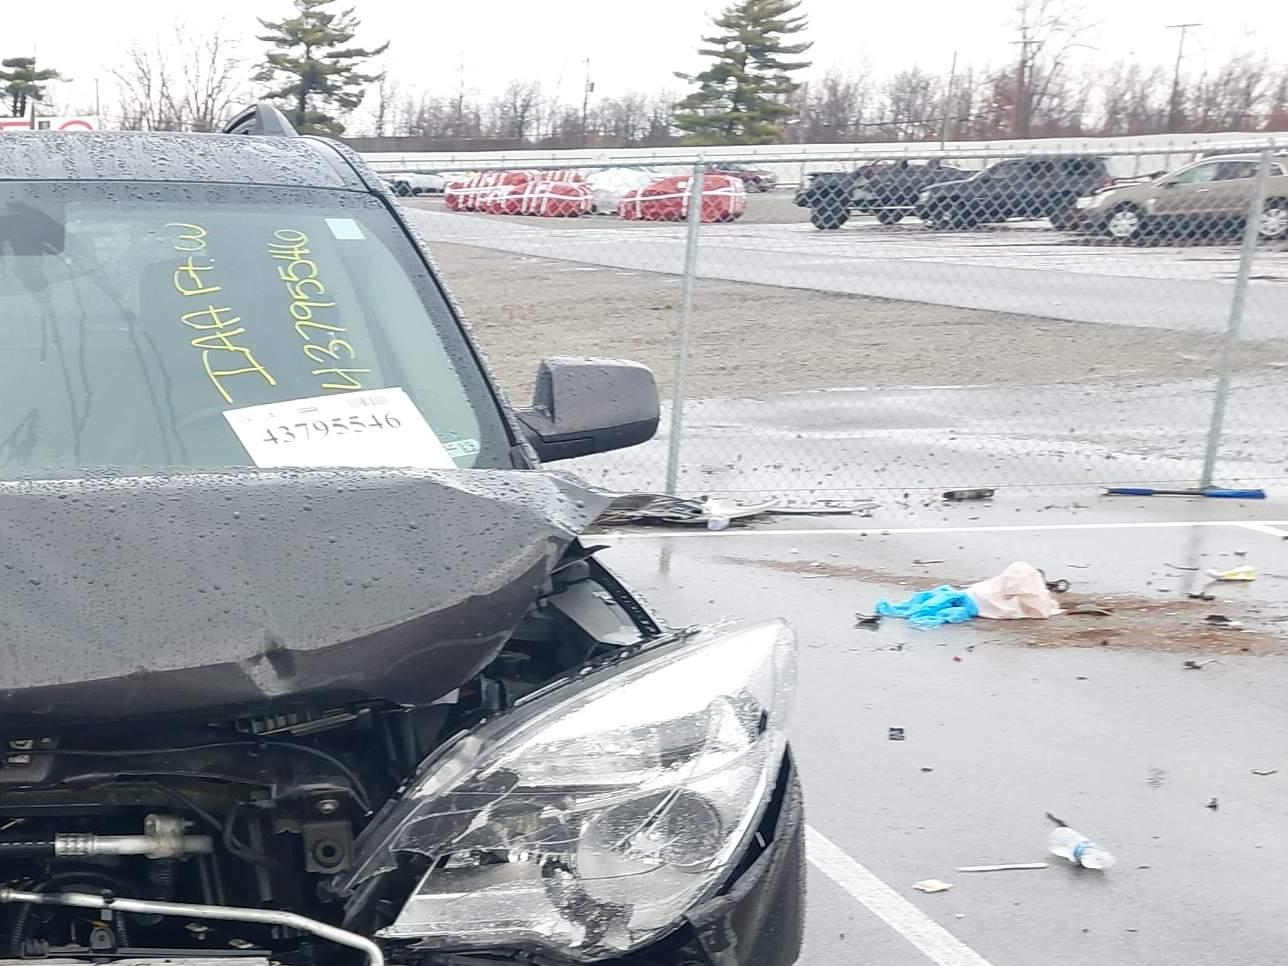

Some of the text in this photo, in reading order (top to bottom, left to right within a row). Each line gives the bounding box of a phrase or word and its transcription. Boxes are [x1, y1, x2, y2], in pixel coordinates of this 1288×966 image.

[181, 305, 276, 403] IAA
[268, 229, 371, 391] 43795546
[264, 413, 401, 445] 43795546
